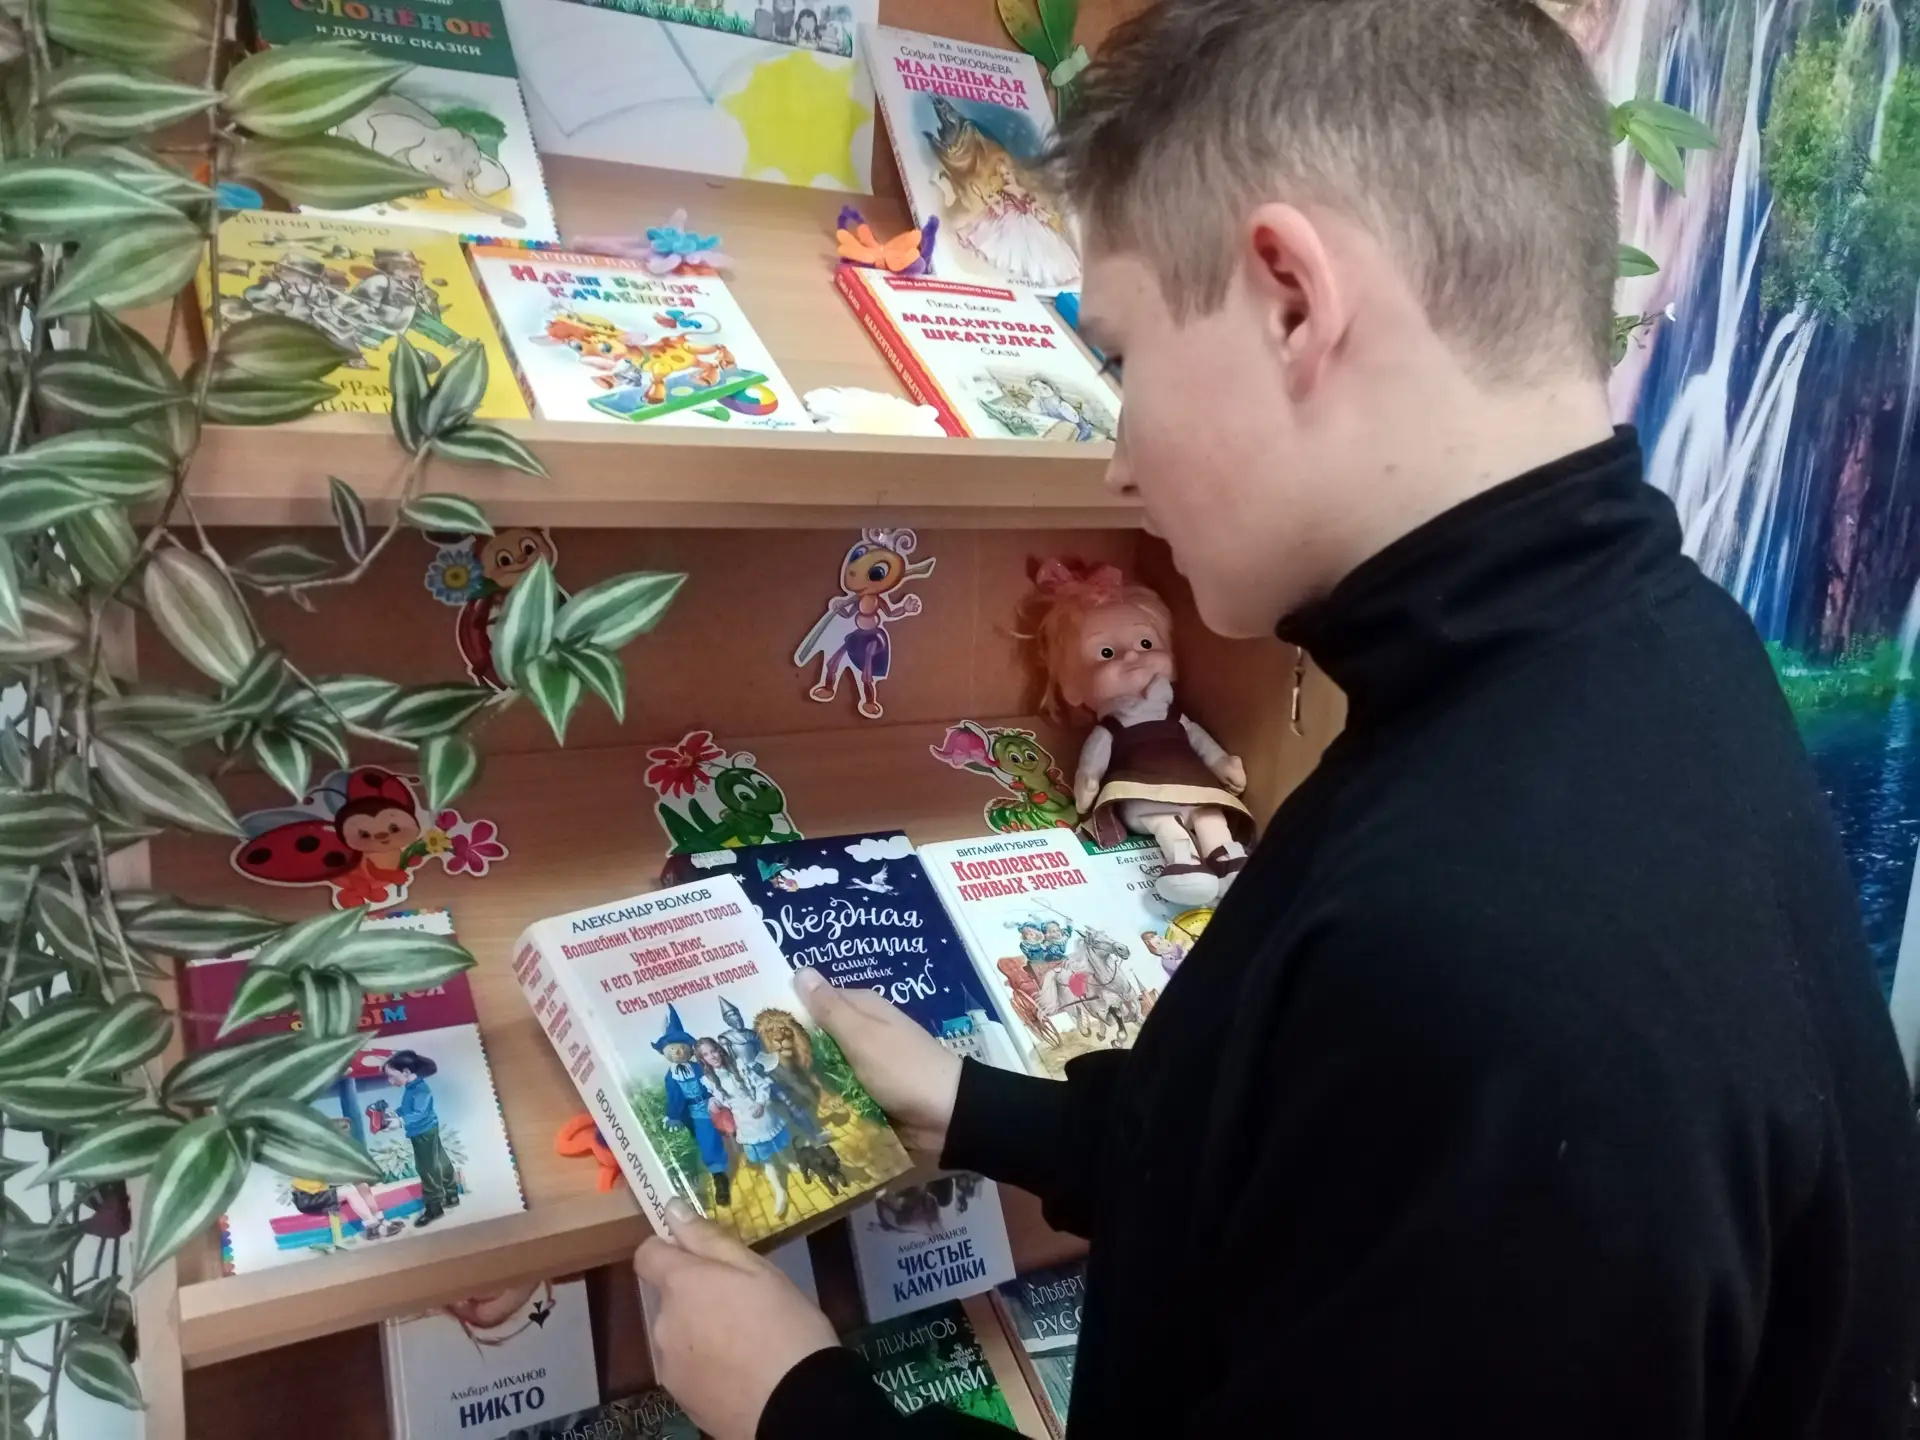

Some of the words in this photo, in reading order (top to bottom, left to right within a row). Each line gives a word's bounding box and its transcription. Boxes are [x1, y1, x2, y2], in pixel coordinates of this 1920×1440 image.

[290, 0, 494, 39] СЛОНЁНОК
[332, 25, 405, 45] ДРУГИЕ
[409, 38, 482, 56] СКАЗКИ
[894, 56, 1027, 94] МАЛЕНЬКАЯ
[900, 46, 936, 60] Софья
[939, 53, 1013, 75] ПРОКОФЬЕВА
[902, 74, 1029, 110] ПРИНЦЕССА
[902, 312, 1055, 335] МАЛАХИТОВАЯ
[921, 328, 1057, 350] ШКАТУЛКА
[956, 842, 1003, 857] ВИТАЛИЙ
[1003, 838, 1048, 855] ГУБАРЕВ
[950, 850, 1070, 882] Королевство
[957, 878, 1027, 902] кривых
[1031, 867, 1087, 893] зеркал
[571, 903, 653, 934] АЛЕКСАНДР
[657, 888, 712, 912] ВОЛКОВ
[560, 932, 631, 961] Волшебник
[630, 914, 705, 944] Изумрудного
[704, 902, 742, 924] города
[612, 973, 633, 991] его
[632, 954, 702, 984] деревянные
[702, 939, 749, 966] солдаты
[630, 946, 671, 968] Урфин
[672, 936, 707, 958] Джюс
[832, 956, 878, 973] самых
[615, 998, 649, 1016] Семь
[648, 977, 713, 1010] подземных
[714, 960, 759, 986] королей
[830, 966, 894, 988] красивых
[595, 1088, 632, 1151] ВОЛКОВ
[928, 1226, 968, 1246] ЛИХАНОВ
[897, 1238, 975, 1276] ЧИСТЫЕ
[893, 1257, 987, 1303] КАМУШКИ
[1031, 1275, 1085, 1307] АЛЬБЕРТ
[876, 1318, 956, 1357] ЛИХАНОВ
[491, 1367, 547, 1391] ЛИХАНОВ
[459, 1385, 545, 1429] НИКТО
